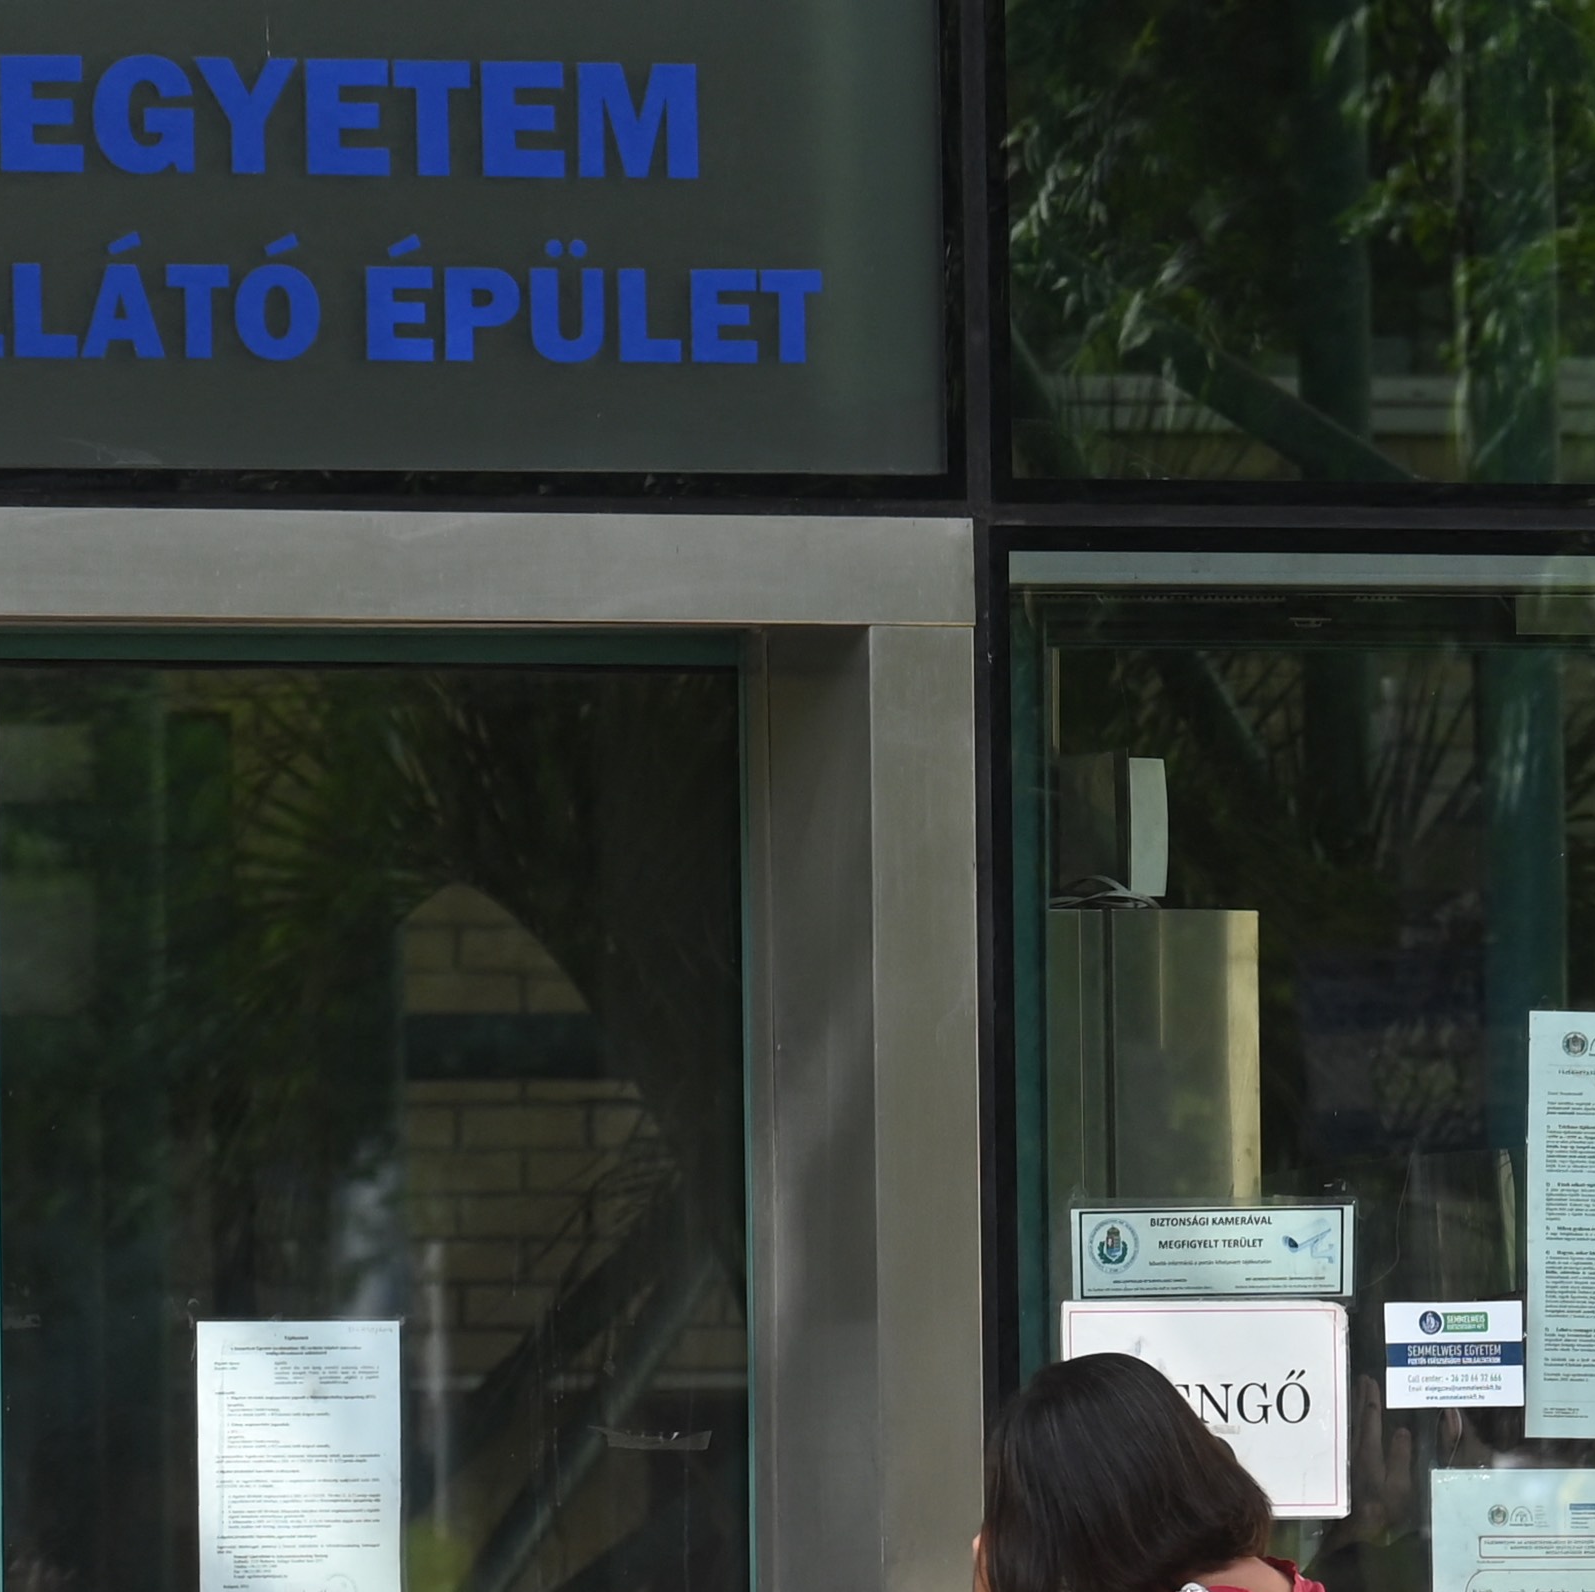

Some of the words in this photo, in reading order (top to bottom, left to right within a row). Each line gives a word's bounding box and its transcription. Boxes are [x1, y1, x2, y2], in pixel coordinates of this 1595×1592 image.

[0, 54, 700, 179] EGYETEM
[366, 235, 823, 364] ÉPÜLET
[1149, 1214, 1210, 1228] BIZTONSÁGI
[1211, 1214, 1273, 1226] KAMERÁVAL
[1158, 1239, 1220, 1250] MEGFIGYELT
[1221, 1236, 1264, 1249] TERÜLET
[1407, 1344, 1462, 1357] SEMMELWEIS
[1464, 1344, 1502, 1356] EGYETEM
